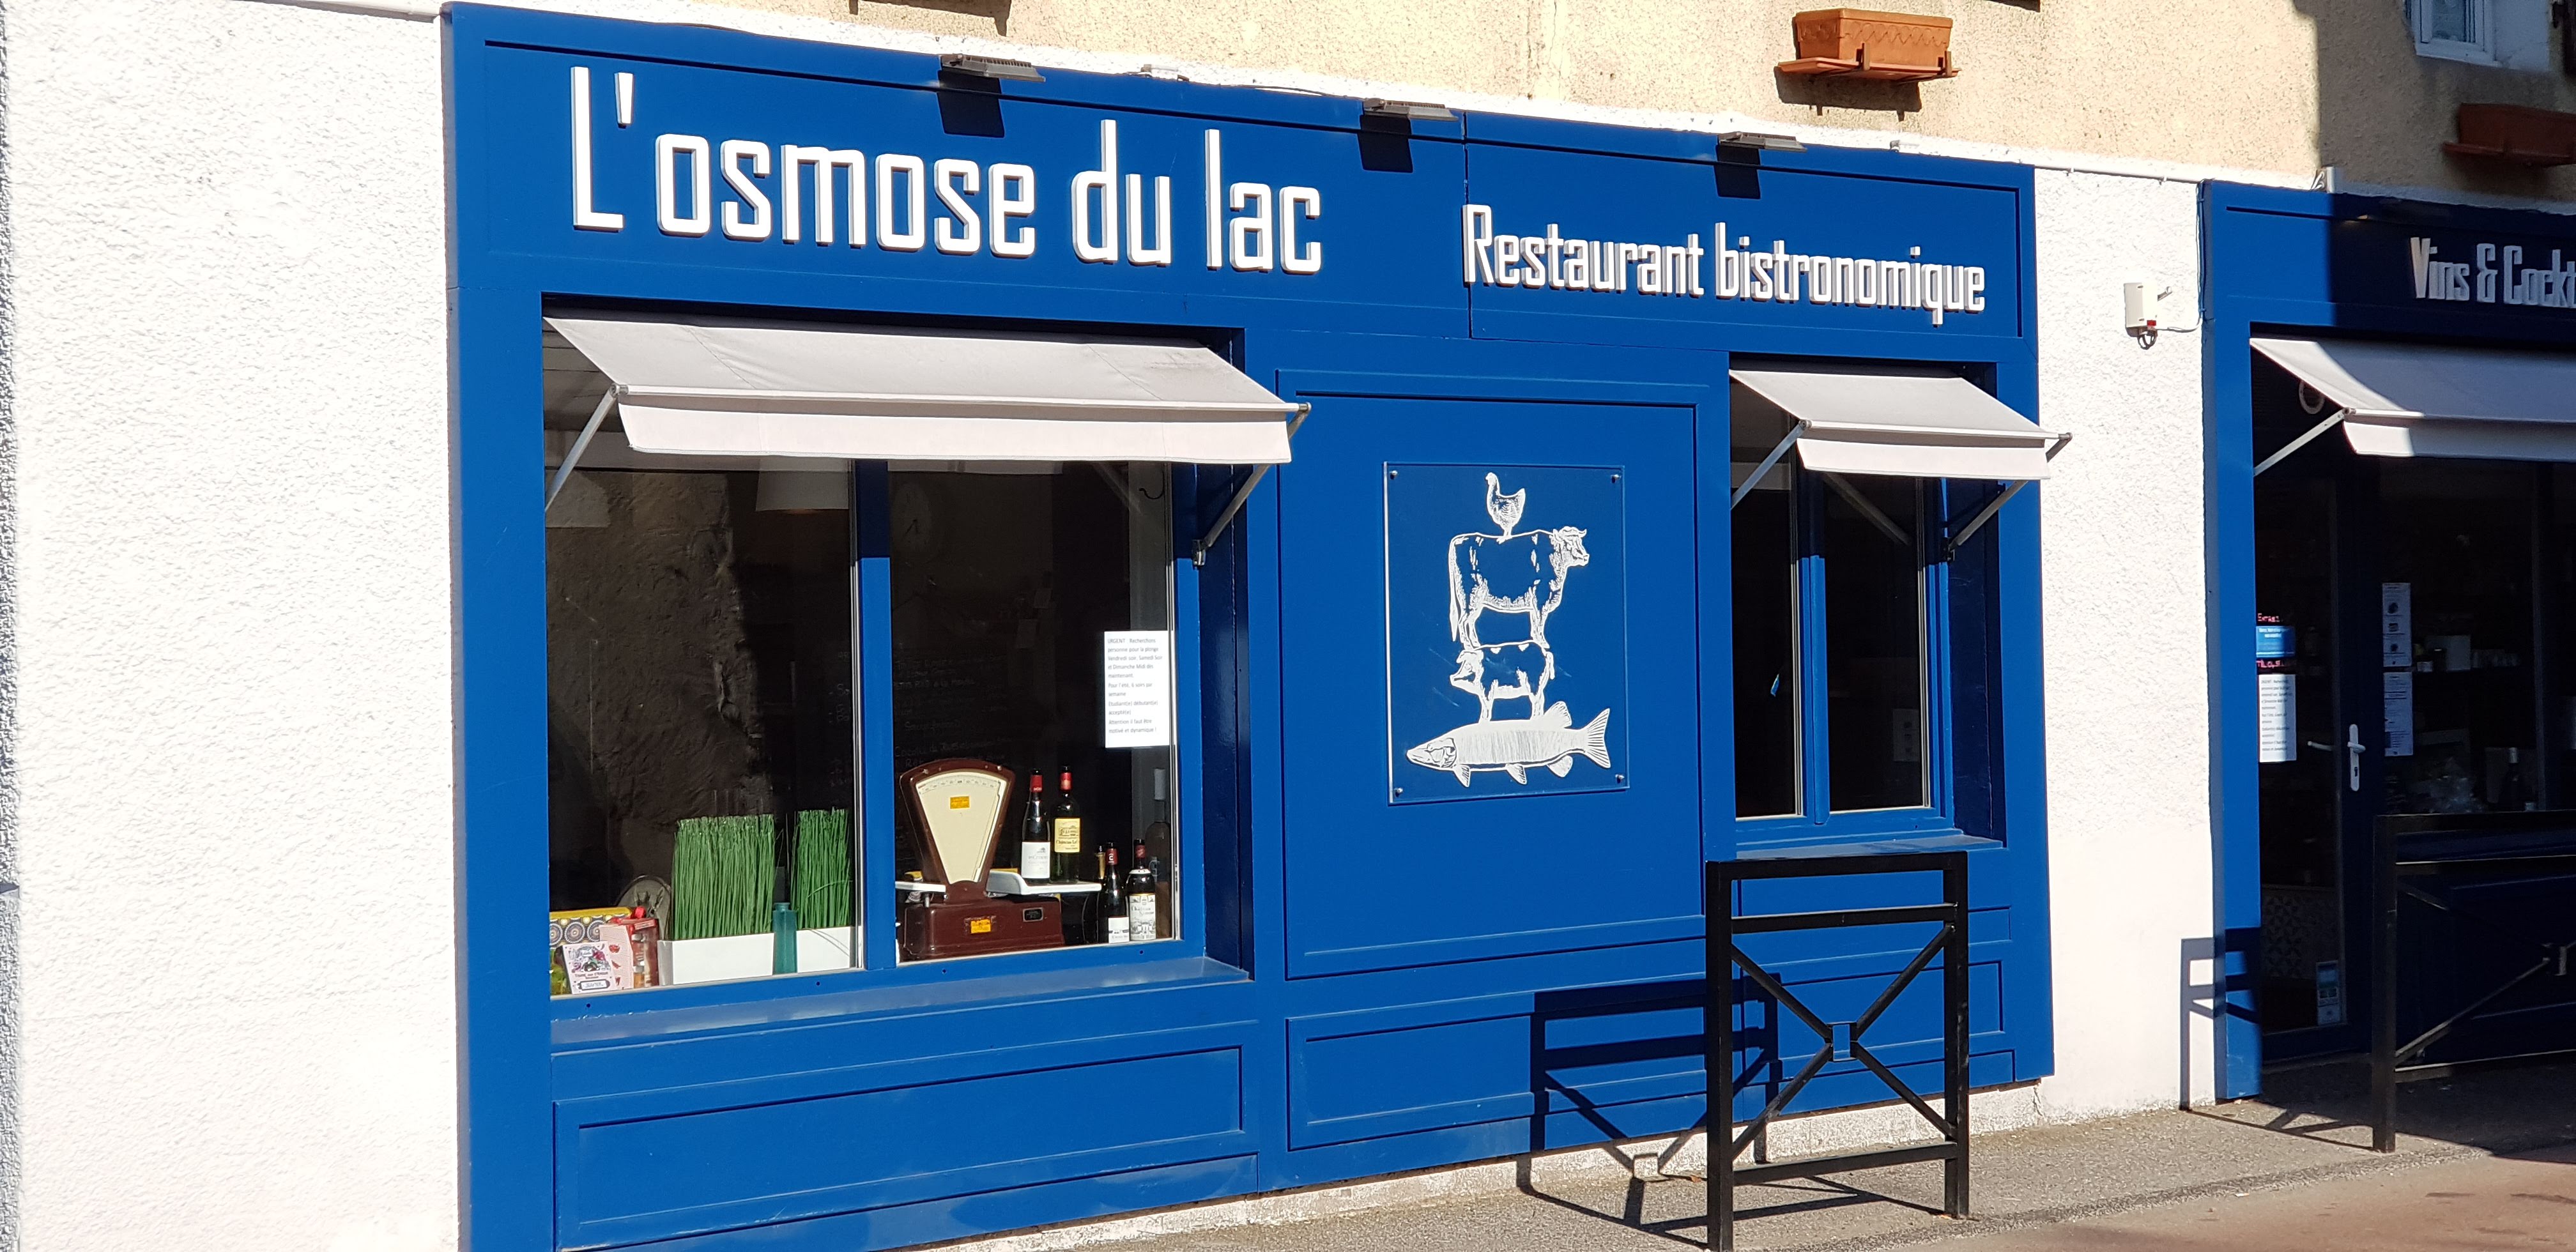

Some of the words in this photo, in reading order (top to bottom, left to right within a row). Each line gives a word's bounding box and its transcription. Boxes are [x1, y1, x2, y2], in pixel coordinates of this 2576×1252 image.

[571, 66, 1036, 257] L'osmose
[1072, 119, 1172, 266] du
[1205, 128, 1321, 275] lac
[1462, 204, 1705, 298] Restaurant
[1714, 222, 1985, 327] bistronomique
[2410, 236, 2470, 302] Vins
[2476, 243, 2498, 303] &
